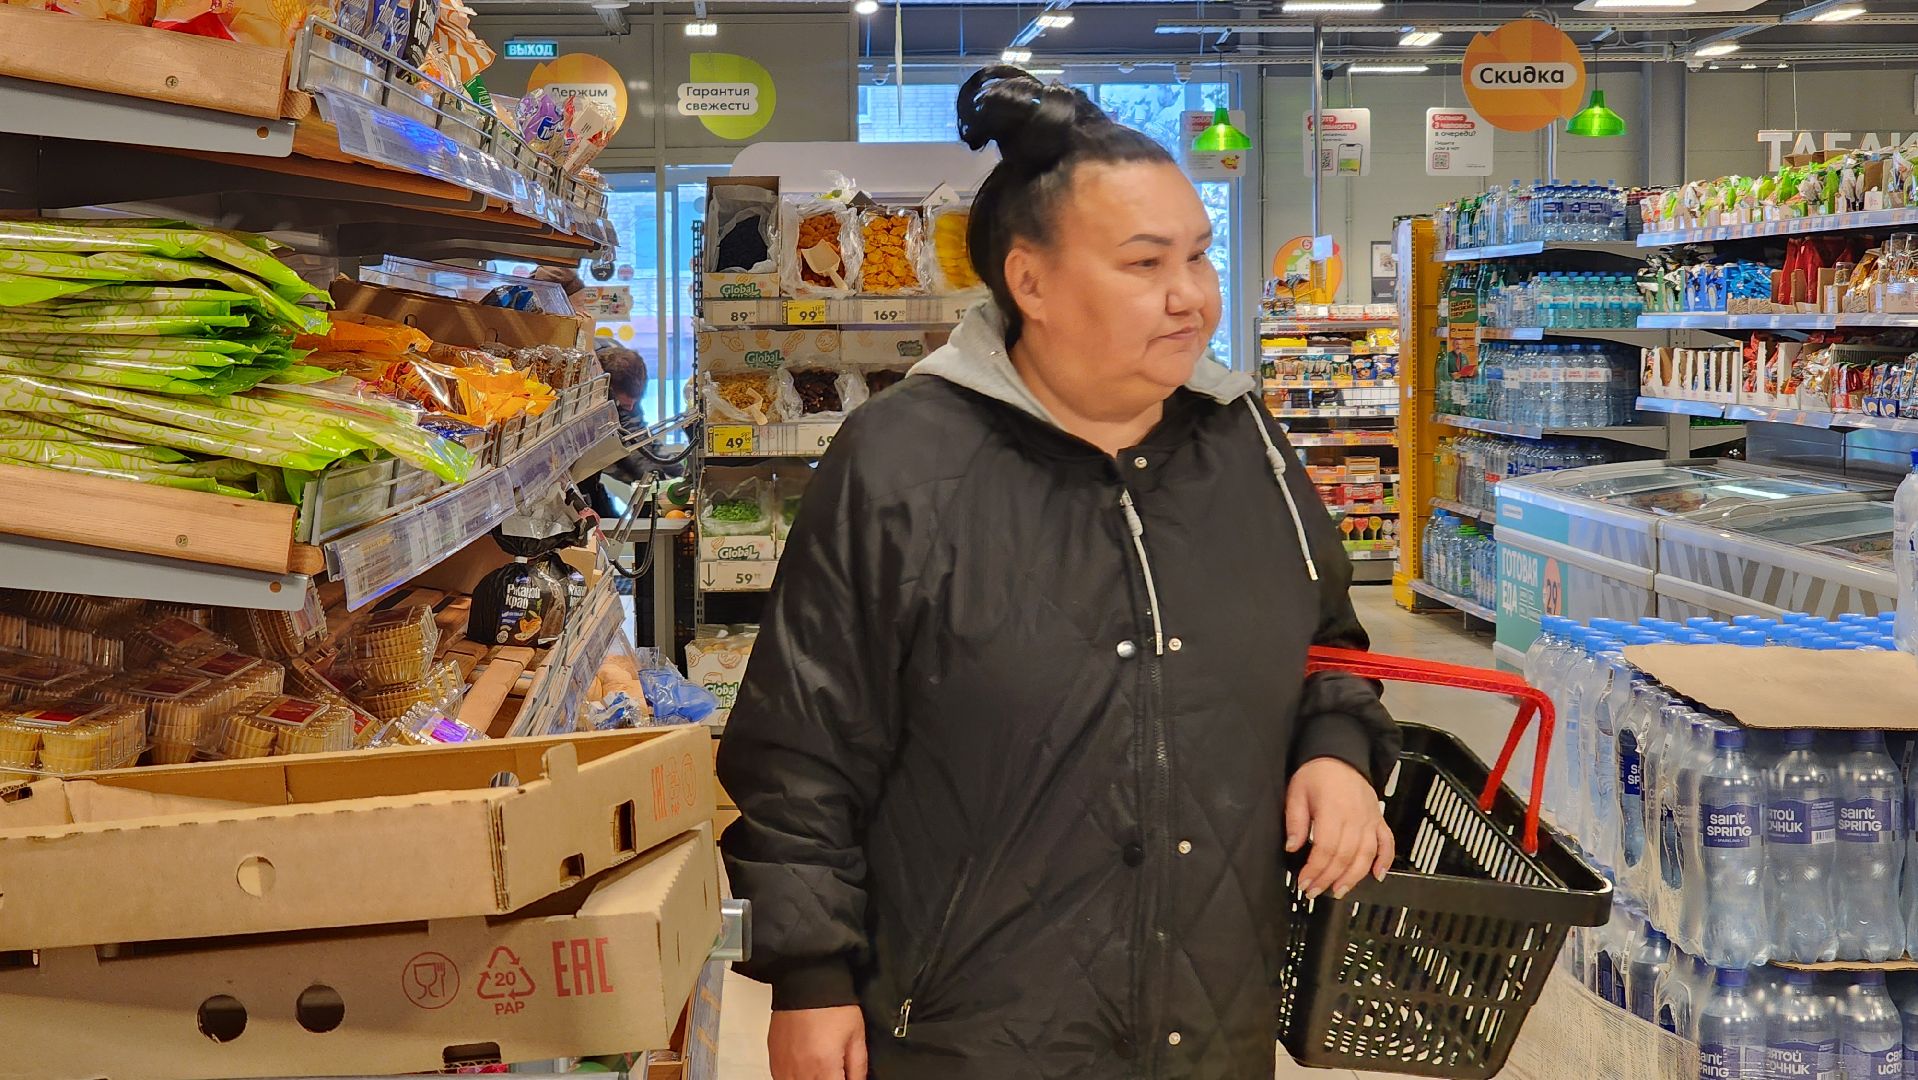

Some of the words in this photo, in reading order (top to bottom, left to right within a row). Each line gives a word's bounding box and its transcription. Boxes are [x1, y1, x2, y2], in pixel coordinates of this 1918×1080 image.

[509, 44, 554, 56] ВЫХОД
[1479, 65, 1565, 84] Скидка
[686, 87, 750, 98] Гарантия
[685, 102, 750, 111] свежести
[722, 283, 759, 295] Global
[731, 312, 748, 321] 89
[800, 311, 817, 321] 99
[873, 310, 898, 320] 169
[746, 351, 784, 363] Global
[726, 438, 743, 448] 49
[719, 545, 759, 559] Global
[1502, 547, 1538, 587] ГОТОВАЯ
[736, 573, 752, 584] 59
[1502, 580, 1518, 617] ЕДА
[1546, 578, 1558, 616] 29
[1706, 825, 1753, 838] SPRING
[1838, 819, 1883, 832] SPRING
[552, 936, 614, 997] EAC
[495, 971, 516, 987] 20
[495, 1001, 525, 1015] PAP
